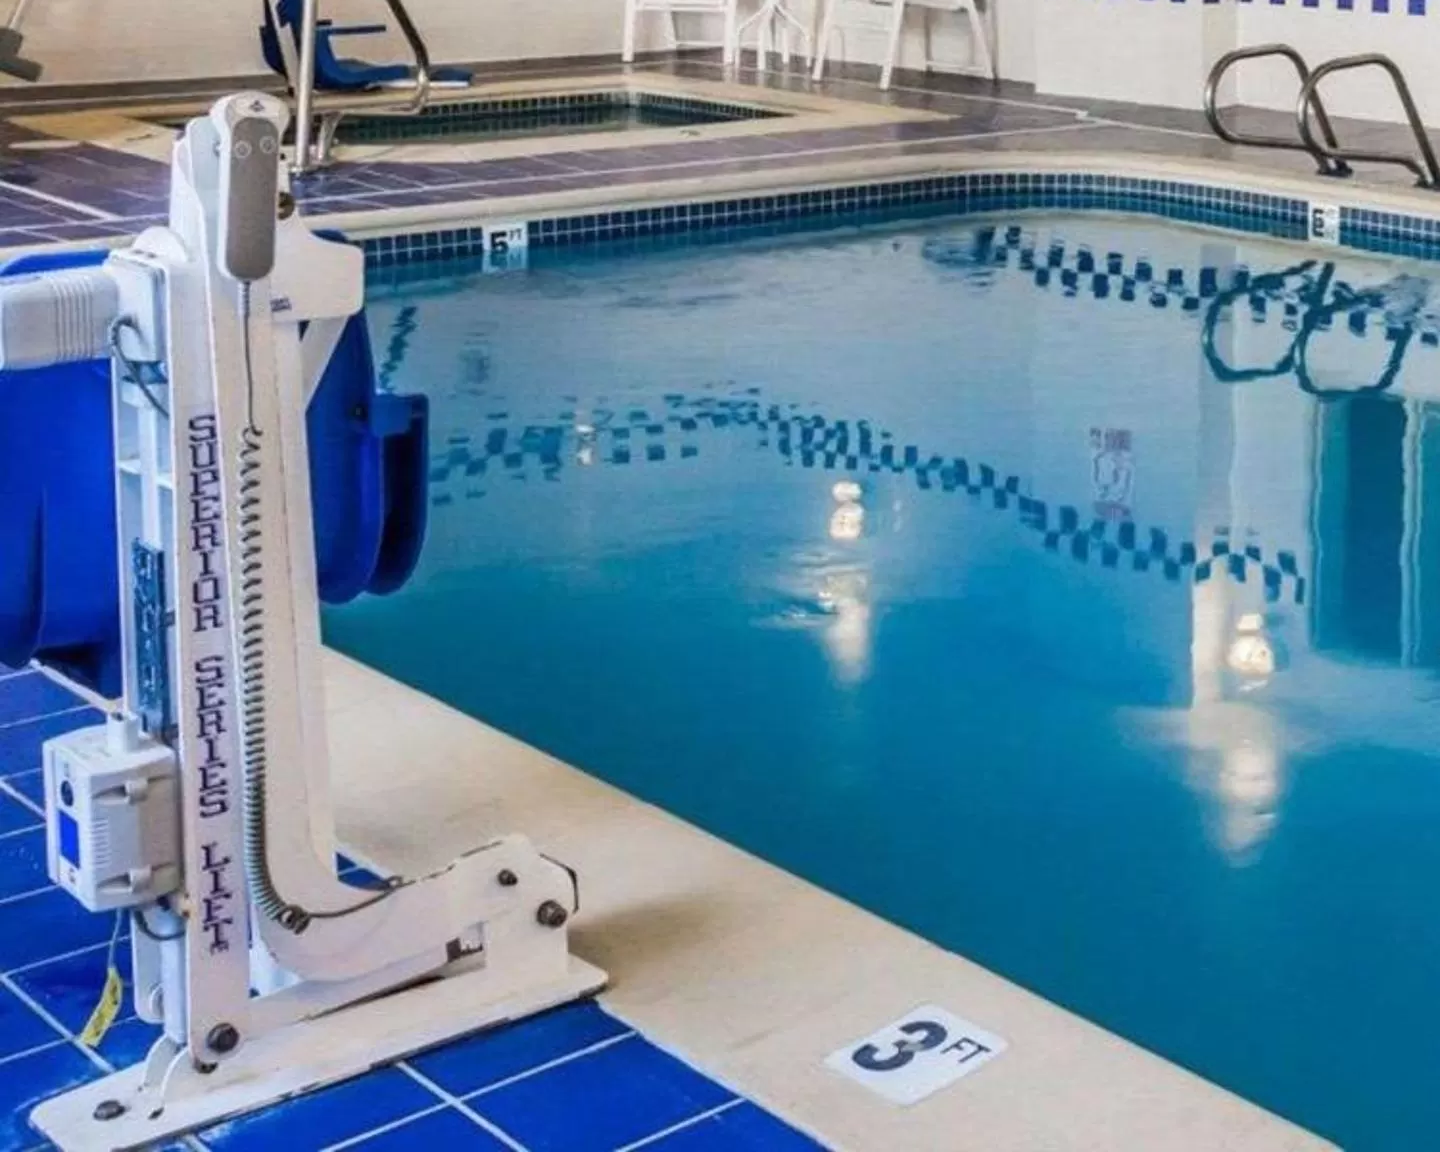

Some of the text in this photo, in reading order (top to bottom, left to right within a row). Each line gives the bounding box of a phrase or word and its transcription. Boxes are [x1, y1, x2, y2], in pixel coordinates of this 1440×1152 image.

[490, 231, 509, 253] 5
[188, 414, 233, 954] SUPERIOR SERIES LIFT
[852, 1020, 992, 1071] 3 FT
